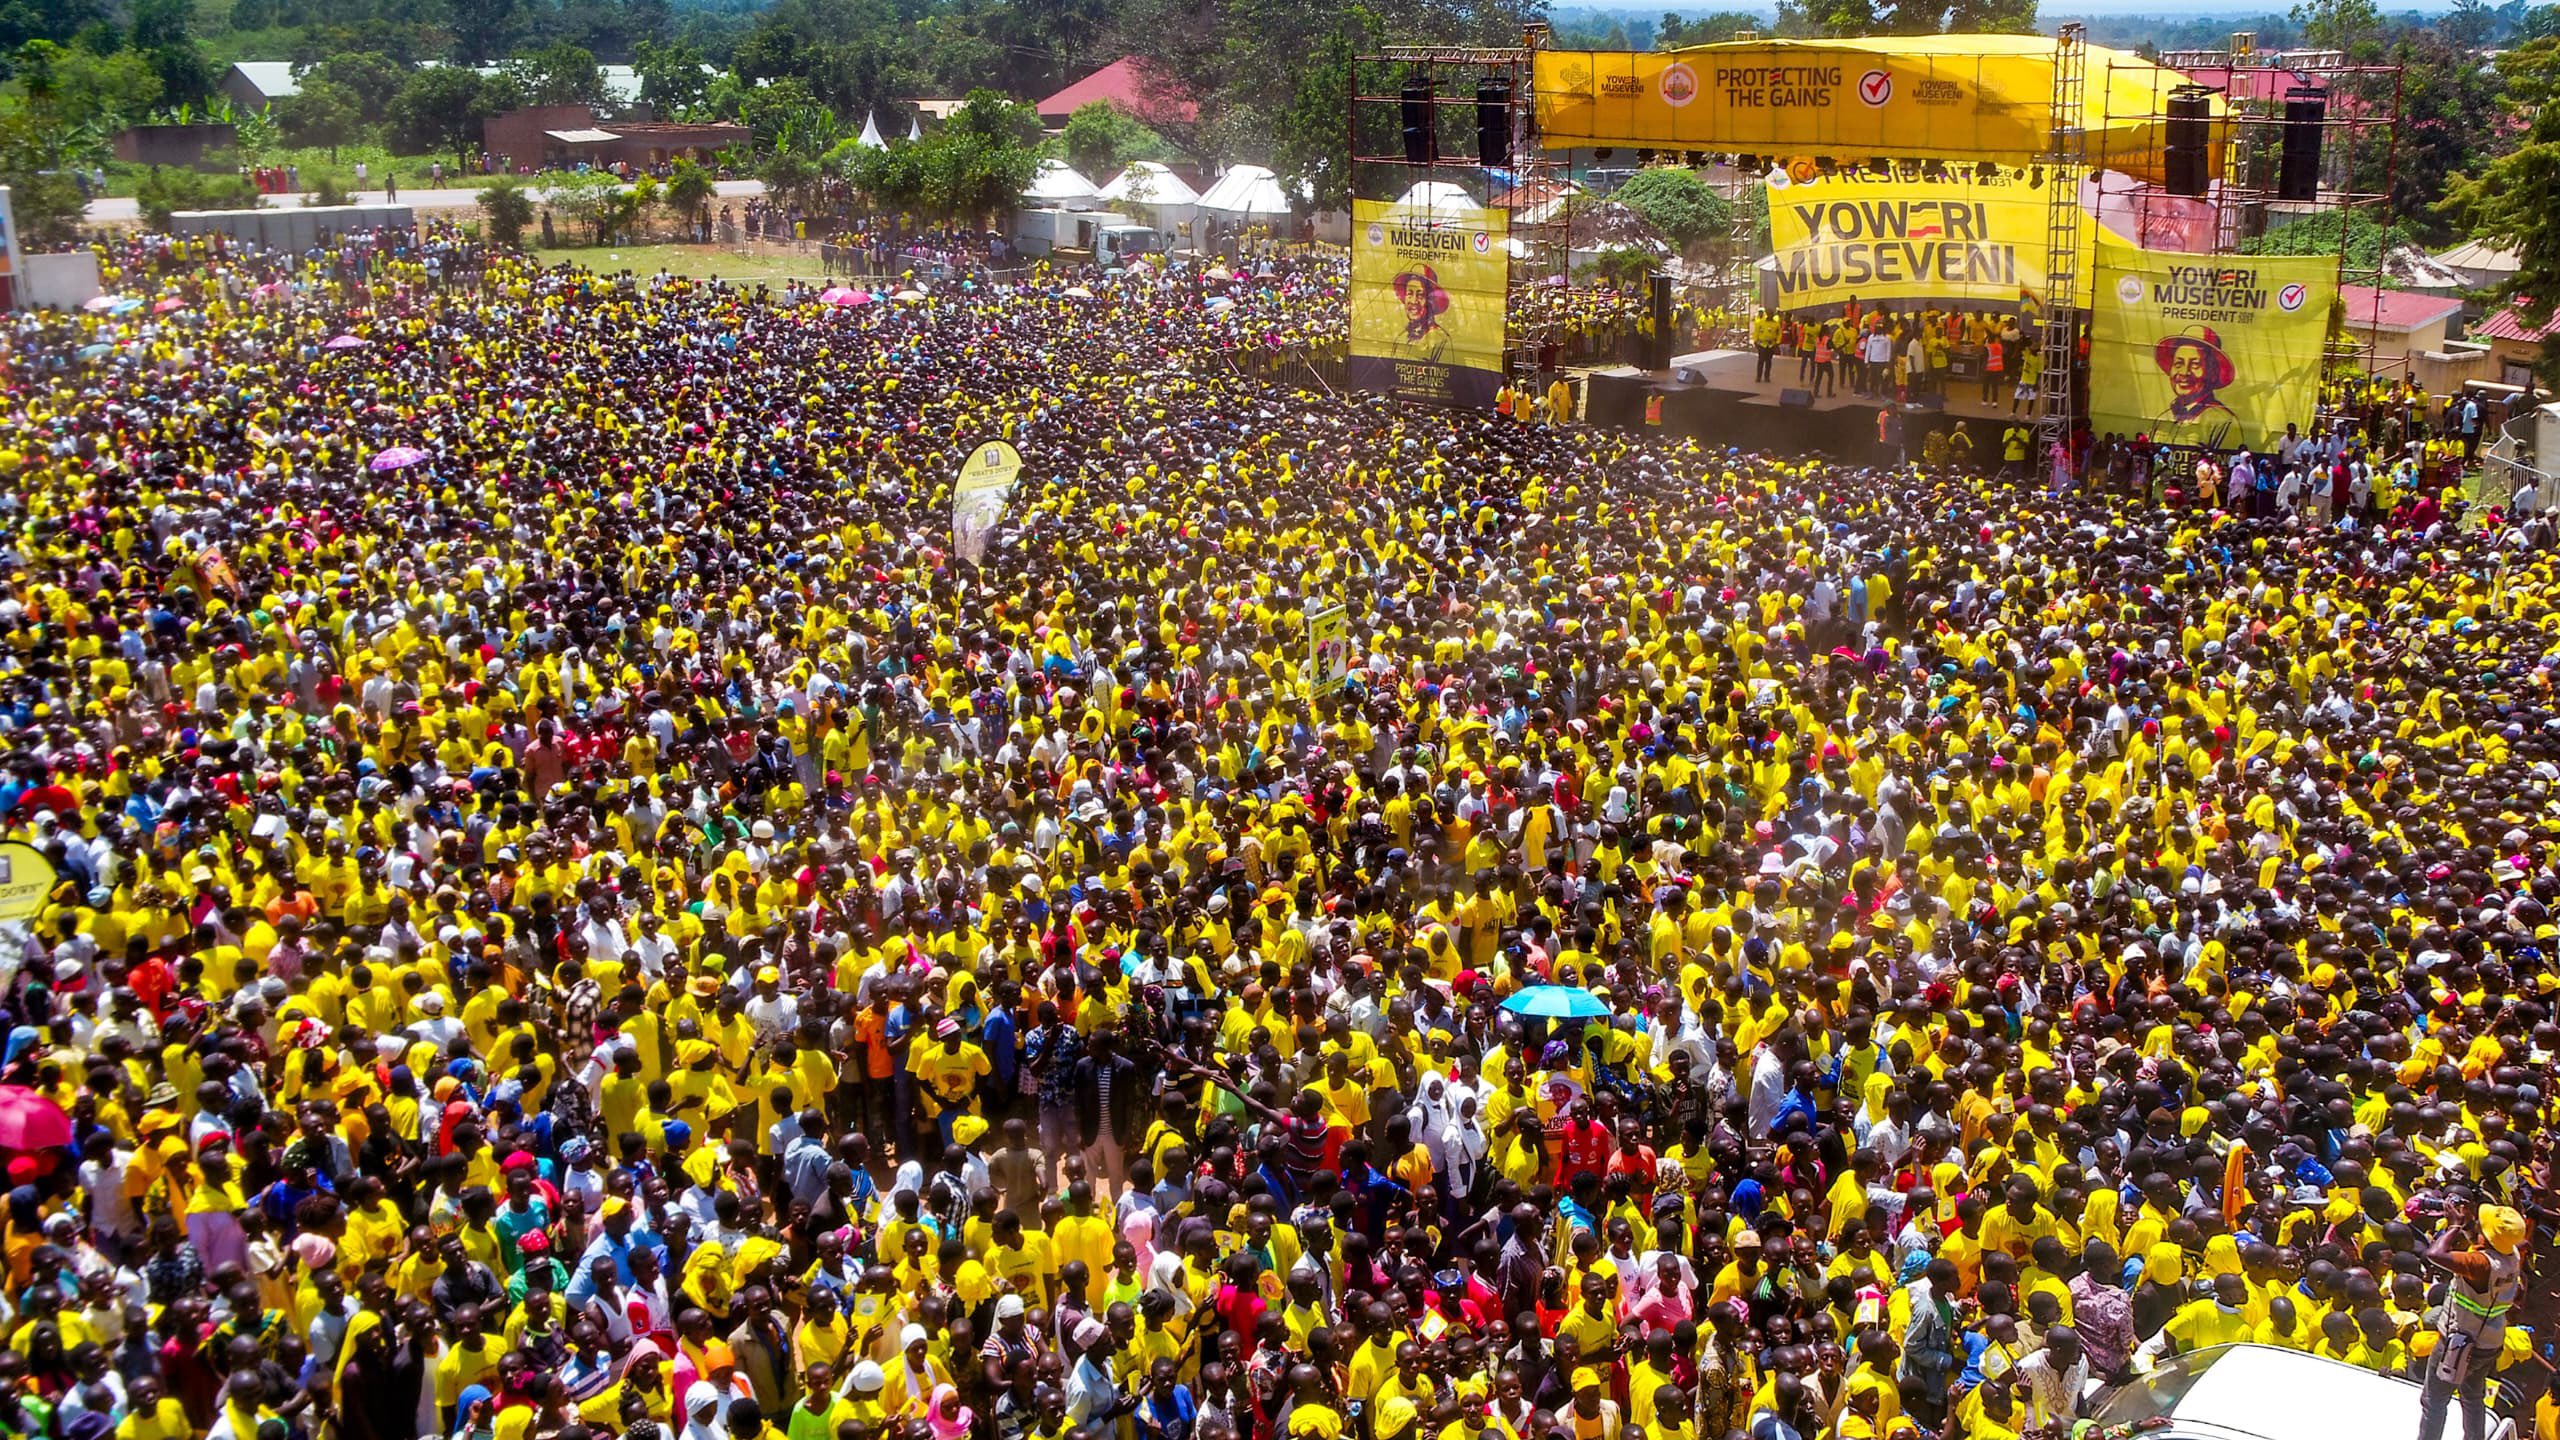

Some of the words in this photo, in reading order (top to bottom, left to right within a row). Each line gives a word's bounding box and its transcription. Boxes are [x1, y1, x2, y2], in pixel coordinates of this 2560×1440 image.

[1606, 75, 1639, 85] YOWERI
[1717, 67, 1841, 88] PROTECTING
[1919, 80, 1957, 90] YOWERI
[1601, 84, 1644, 93] MUSEVENI
[1912, 89, 1963, 99] MUSEVENI
[1726, 89, 1765, 107] THE
[1775, 88, 1831, 108] GAINS
[1794, 200, 1988, 244] YOWERI
[1391, 230, 1466, 250] MUSEVENI
[1397, 248, 1447, 262] PRESIDENT
[1773, 241, 2015, 294] MUSEVENI
[2168, 265, 2257, 289] YOWERI
[2154, 284, 2267, 309] MUSEVENI
[2162, 306, 2237, 324] PRESIDENT
[1395, 362, 1449, 378] PROTECTING
[1400, 373, 1416, 385] THE
[1417, 375, 1445, 388] GAINS
